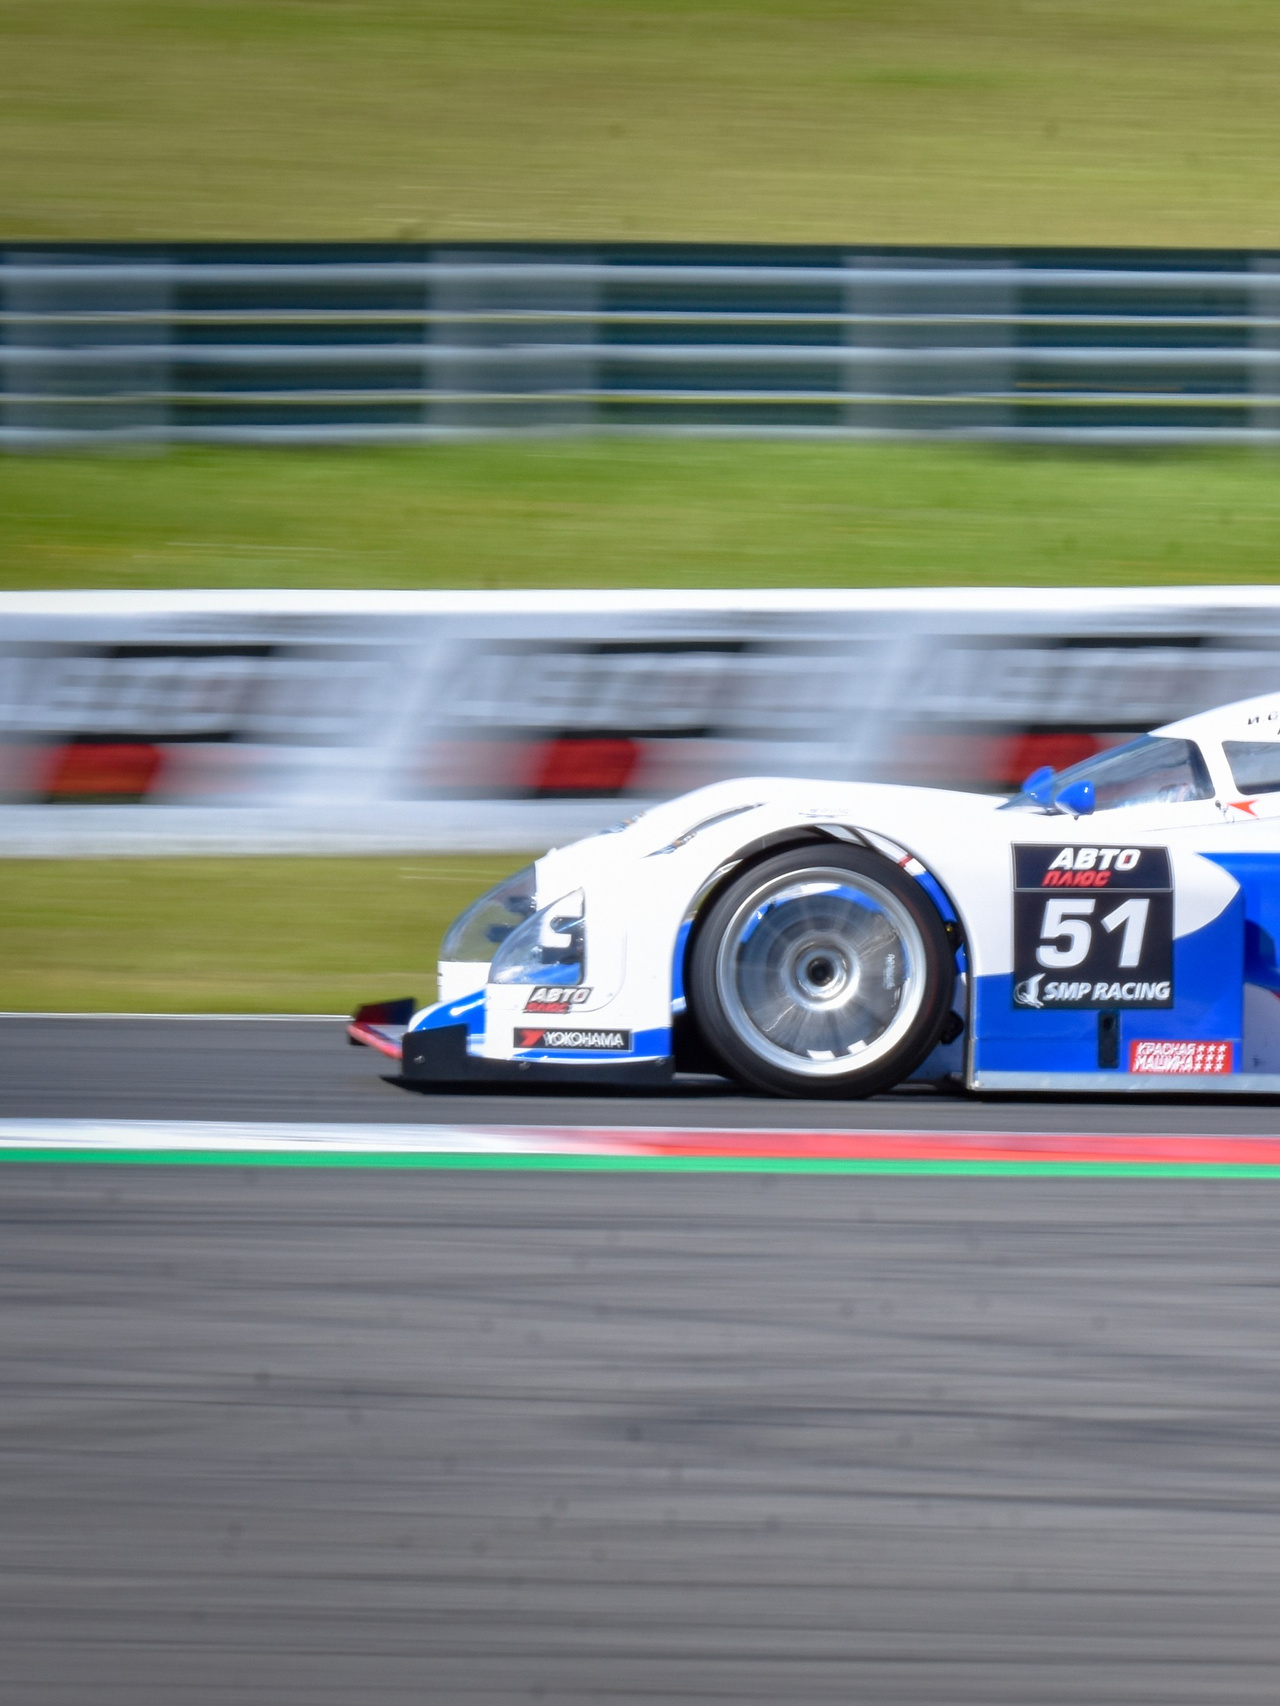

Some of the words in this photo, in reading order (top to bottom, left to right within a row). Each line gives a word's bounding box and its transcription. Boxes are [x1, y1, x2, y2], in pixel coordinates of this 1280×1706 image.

[1048, 847, 1142, 871] АВТО
[1041, 870, 1113, 887] ПЛЮС
[1035, 898, 1150, 969] 51
[529, 987, 591, 1003] АВТО
[1042, 982, 1092, 1001] SMP
[1092, 981, 1171, 1001] RACING
[544, 1031, 625, 1048] YOKOHAMA
